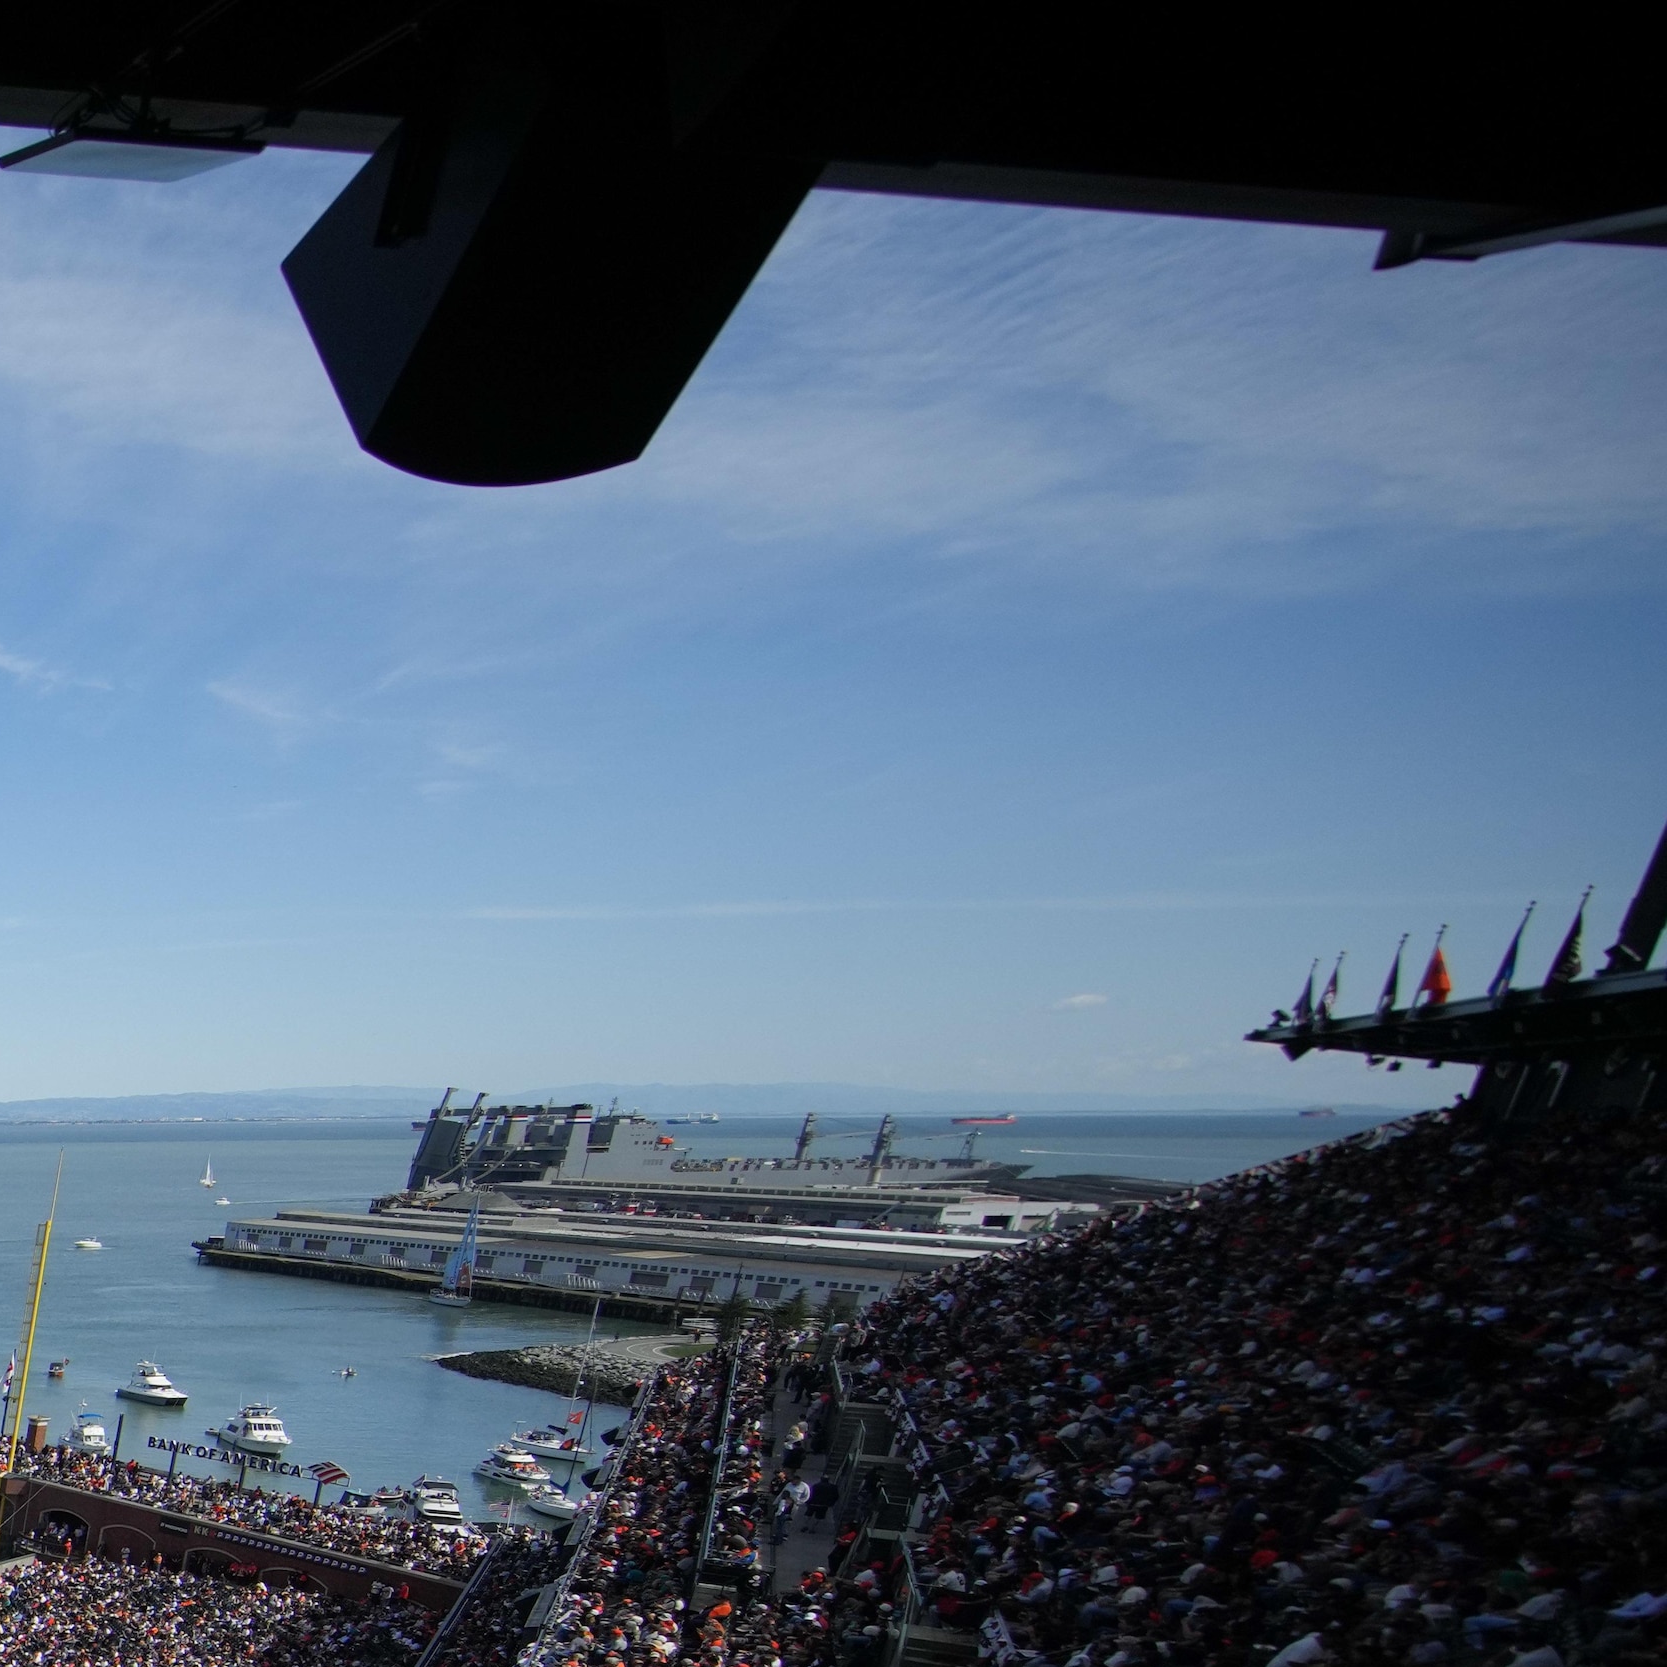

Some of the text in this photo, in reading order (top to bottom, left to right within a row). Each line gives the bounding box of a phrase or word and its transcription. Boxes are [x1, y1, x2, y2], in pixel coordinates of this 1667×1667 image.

[148, 1436, 302, 1478] BANK OF AMERICA
